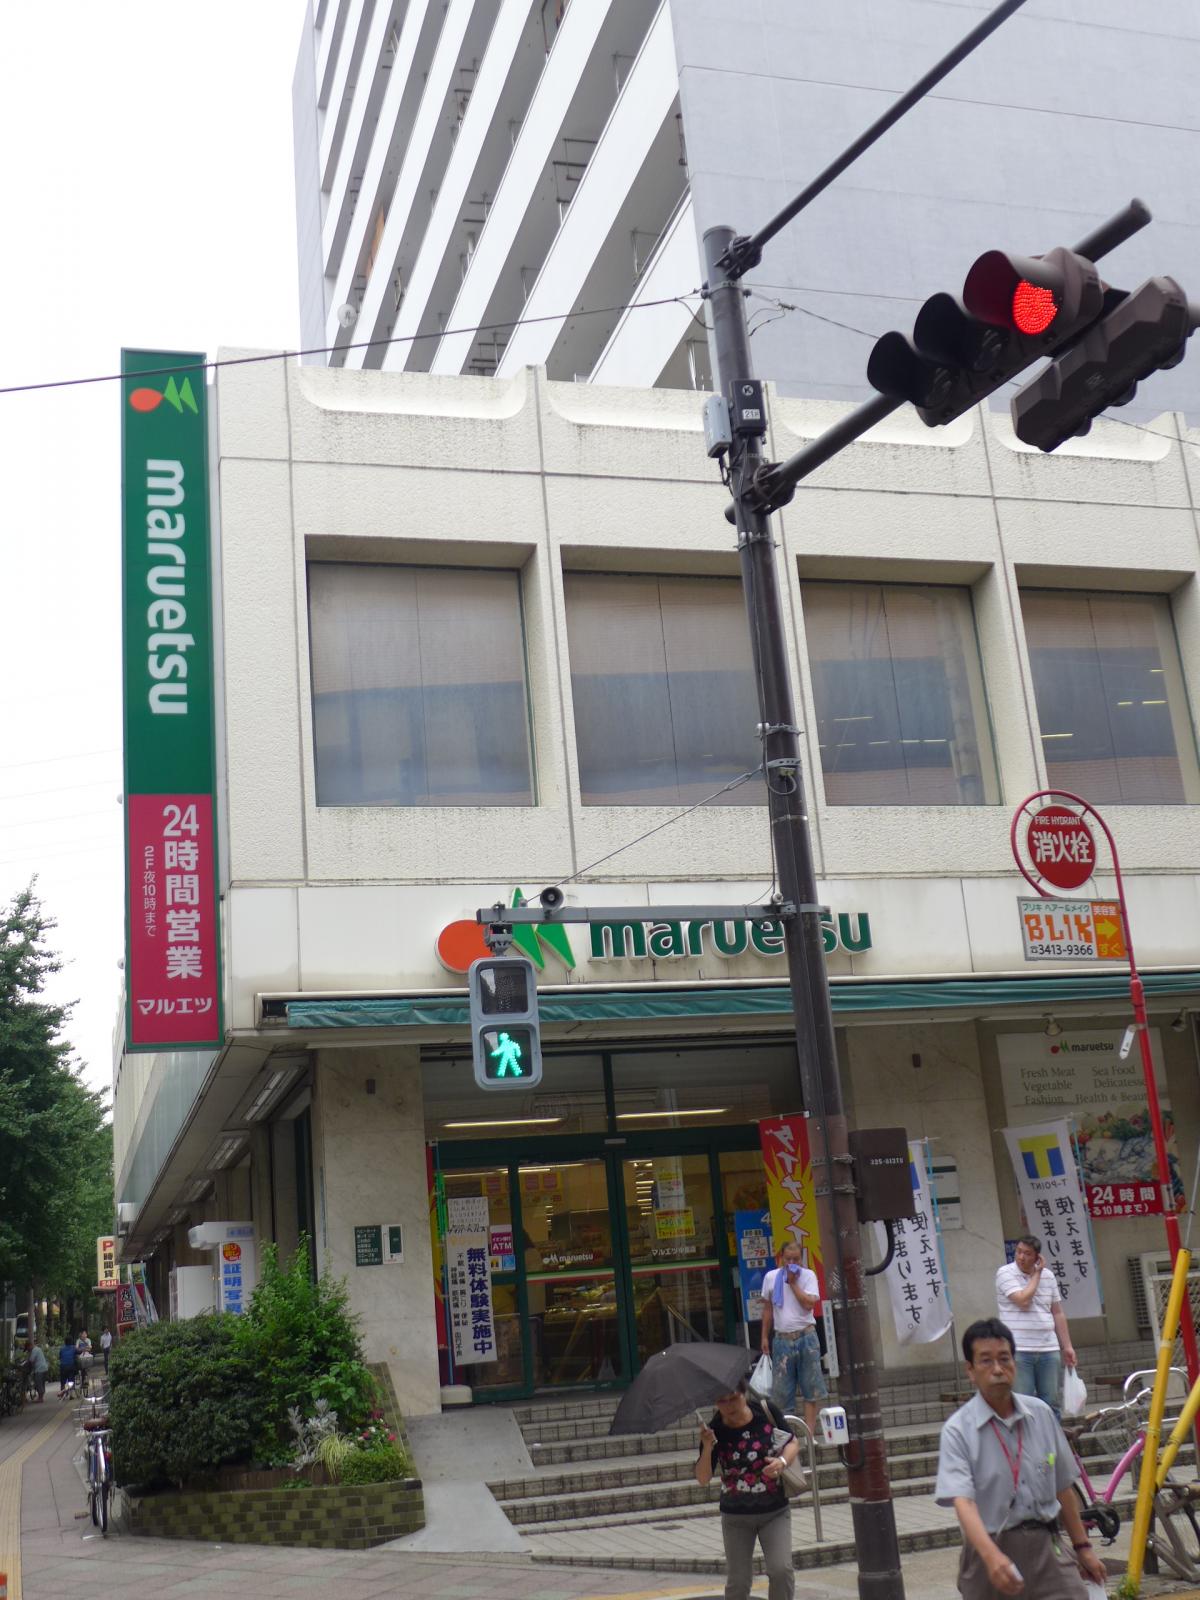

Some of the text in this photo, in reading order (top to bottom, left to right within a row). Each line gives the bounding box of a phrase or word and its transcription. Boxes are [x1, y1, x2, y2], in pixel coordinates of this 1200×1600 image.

[146, 458, 196, 715] maruetsu
[1035, 816, 1081, 826] FIRE HYDRANT
[1032, 831, 1092, 863] 消火栓
[143, 846, 156, 937] 2F夜10時まで
[162, 804, 202, 979] 24時間営業
[1025, 914, 1093, 943] BLIK
[591, 912, 872, 958] maruesu
[1038, 945, 1093, 956] 3413-9366
[137, 997, 213, 1016] マルエツ
[1071, 1042, 1114, 1052] maruetsu
[1020, 1067, 1076, 1078] Fresh Meat
[1092, 1064, 1136, 1076] Sea Food
[1023, 1080, 1072, 1093] Vegetable
[1025, 1094, 1064, 1105] Fashion
[1075, 1093, 1108, 1105] Health
[102, 1240, 114, 1251] P
[493, 1243, 512, 1251] ATM
[559, 1253, 594, 1262] maruetsu
[467, 1247, 493, 1355] 無料体験実施中
